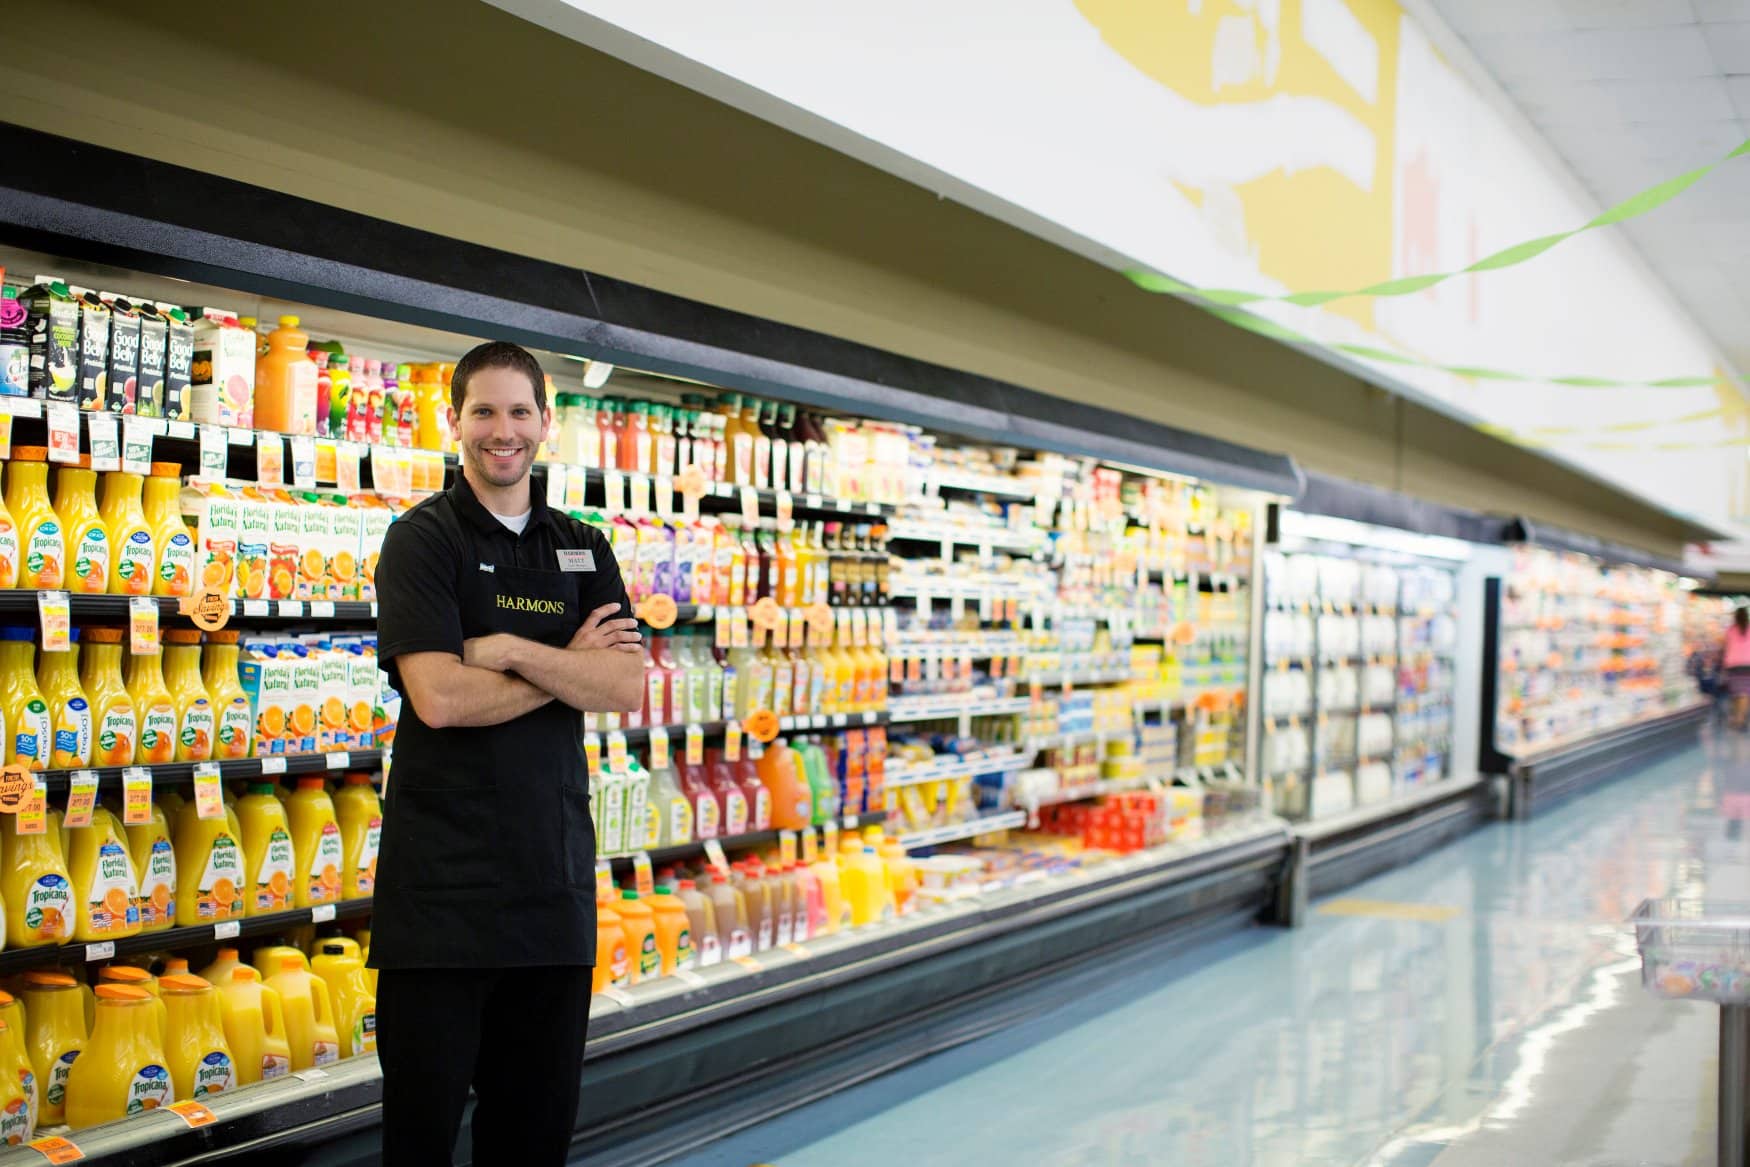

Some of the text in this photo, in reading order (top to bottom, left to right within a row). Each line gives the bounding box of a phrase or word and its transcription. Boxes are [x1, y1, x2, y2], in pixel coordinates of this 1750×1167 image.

[113, 330, 139, 348] Good
[113, 345, 135, 365] Belly
[170, 340, 193, 357] Good
[142, 349, 162, 369] Belly
[169, 353, 190, 374] Belly
[496, 595, 565, 614] HARMONS
[107, 716, 134, 728] Tropicana
[148, 714, 174, 726] Tropicana
[32, 888, 68, 905] Tropicana
[199, 1064, 230, 1082] Tropicana
[134, 1078, 167, 1096] Tropicana
